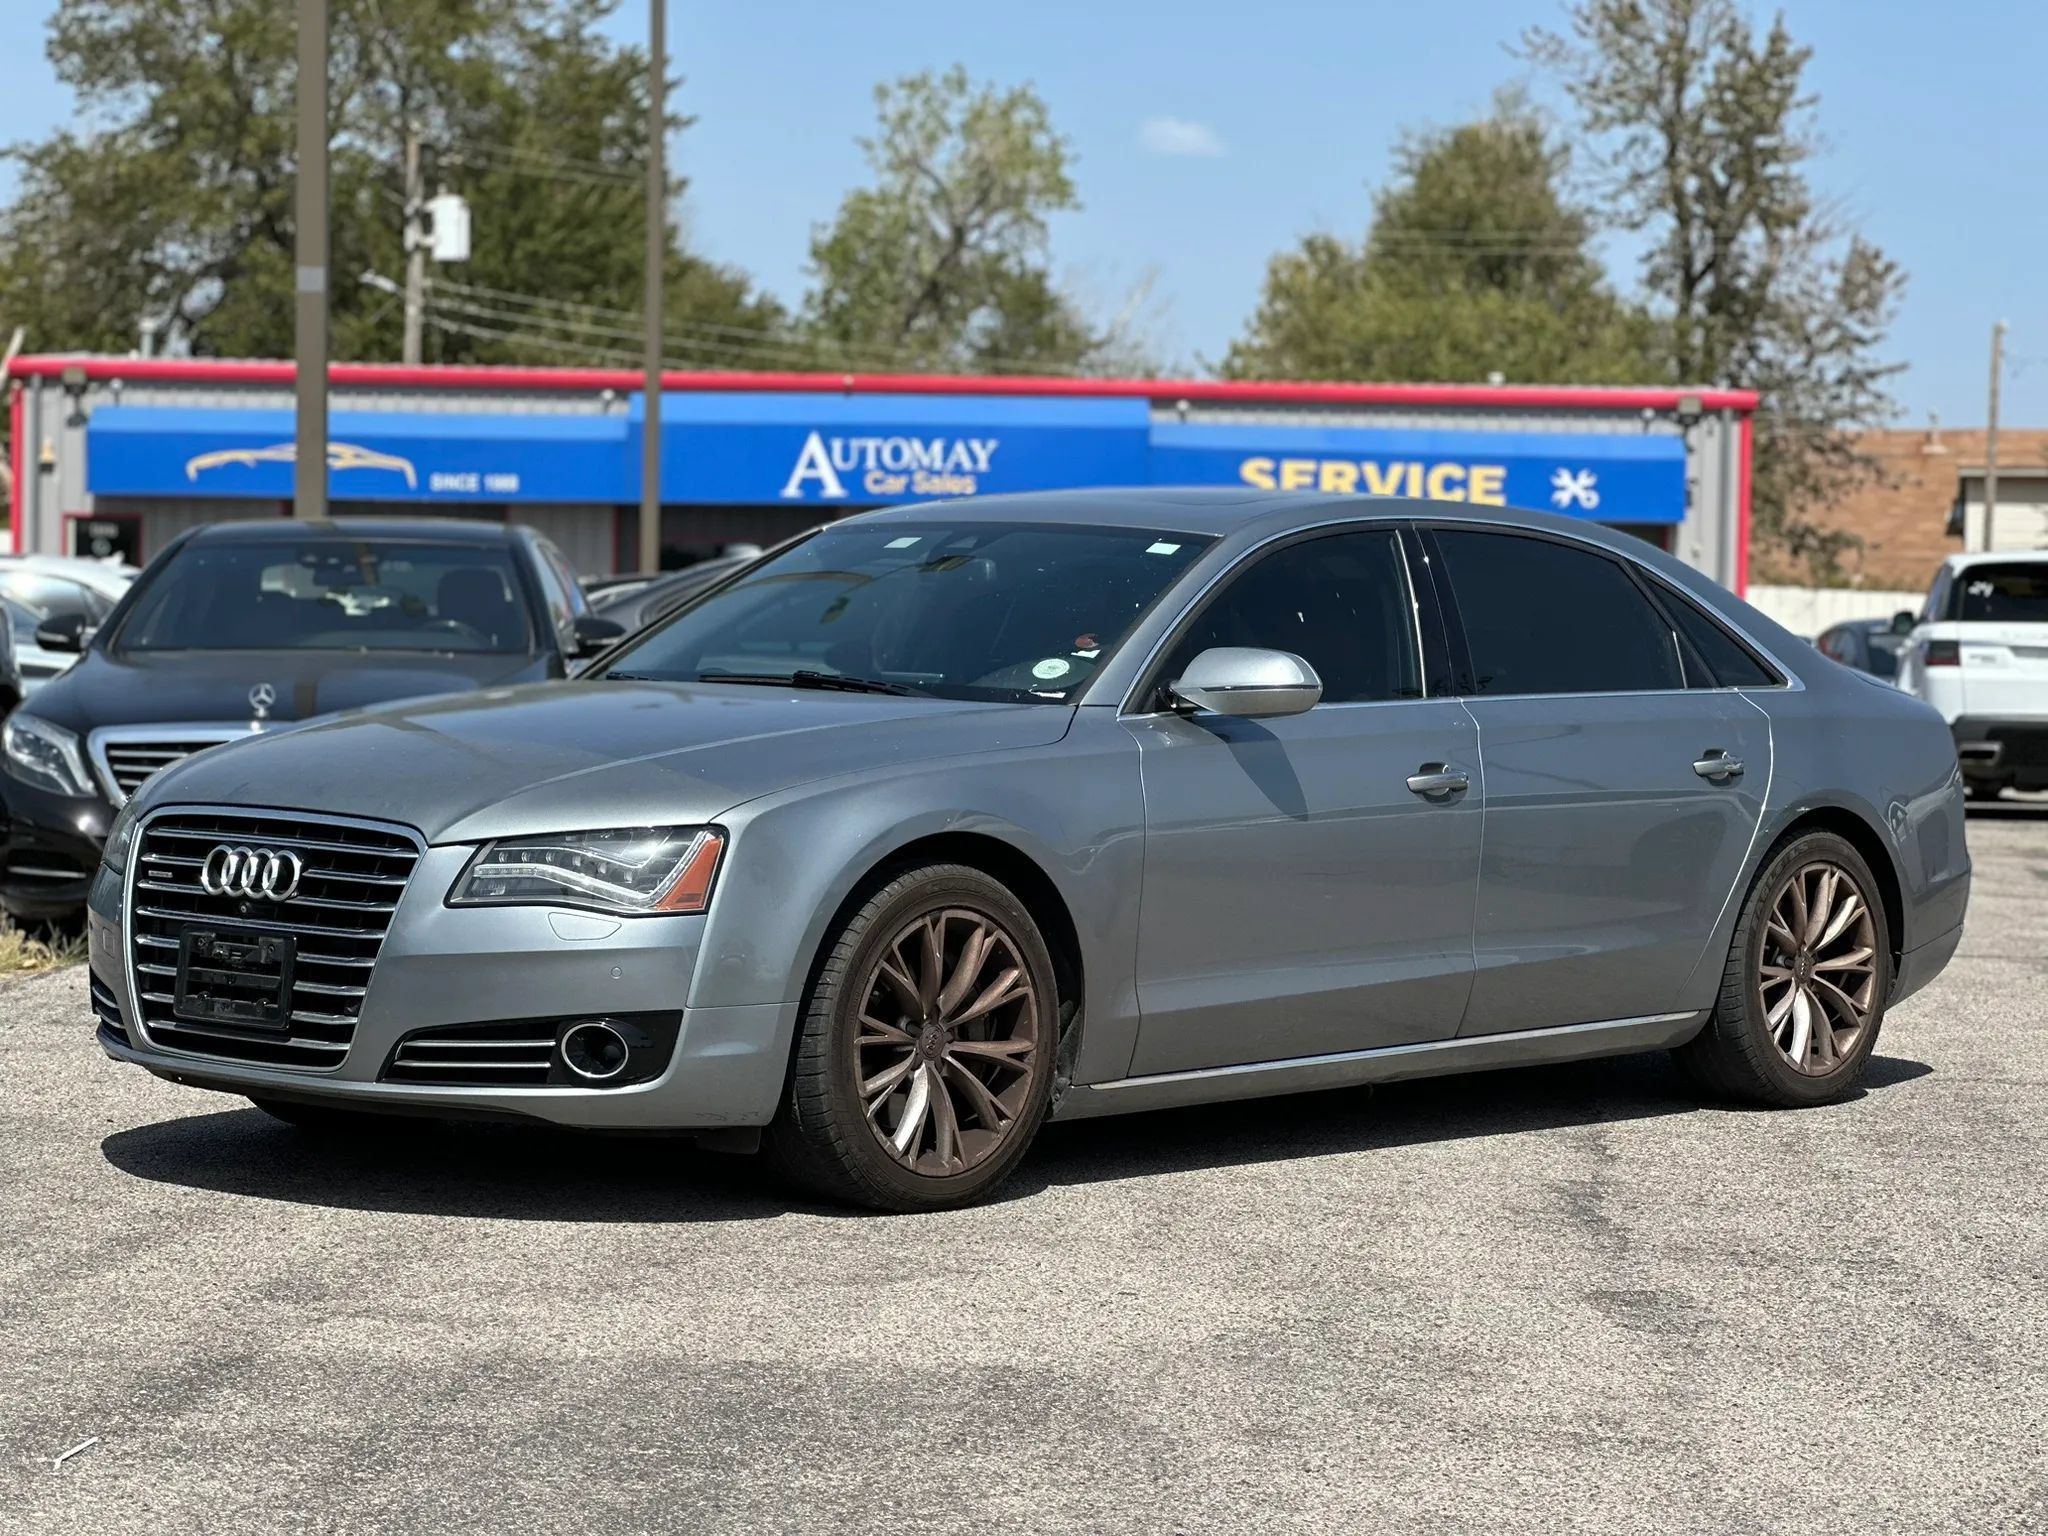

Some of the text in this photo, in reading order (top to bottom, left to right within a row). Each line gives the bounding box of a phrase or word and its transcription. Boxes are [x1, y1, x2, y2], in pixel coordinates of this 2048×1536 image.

[430, 472, 479, 493] SINCE
[780, 430, 998, 498] AUTOMAY
[864, 470, 977, 495] Car Sales
[1240, 457, 1507, 507] SERVICE
